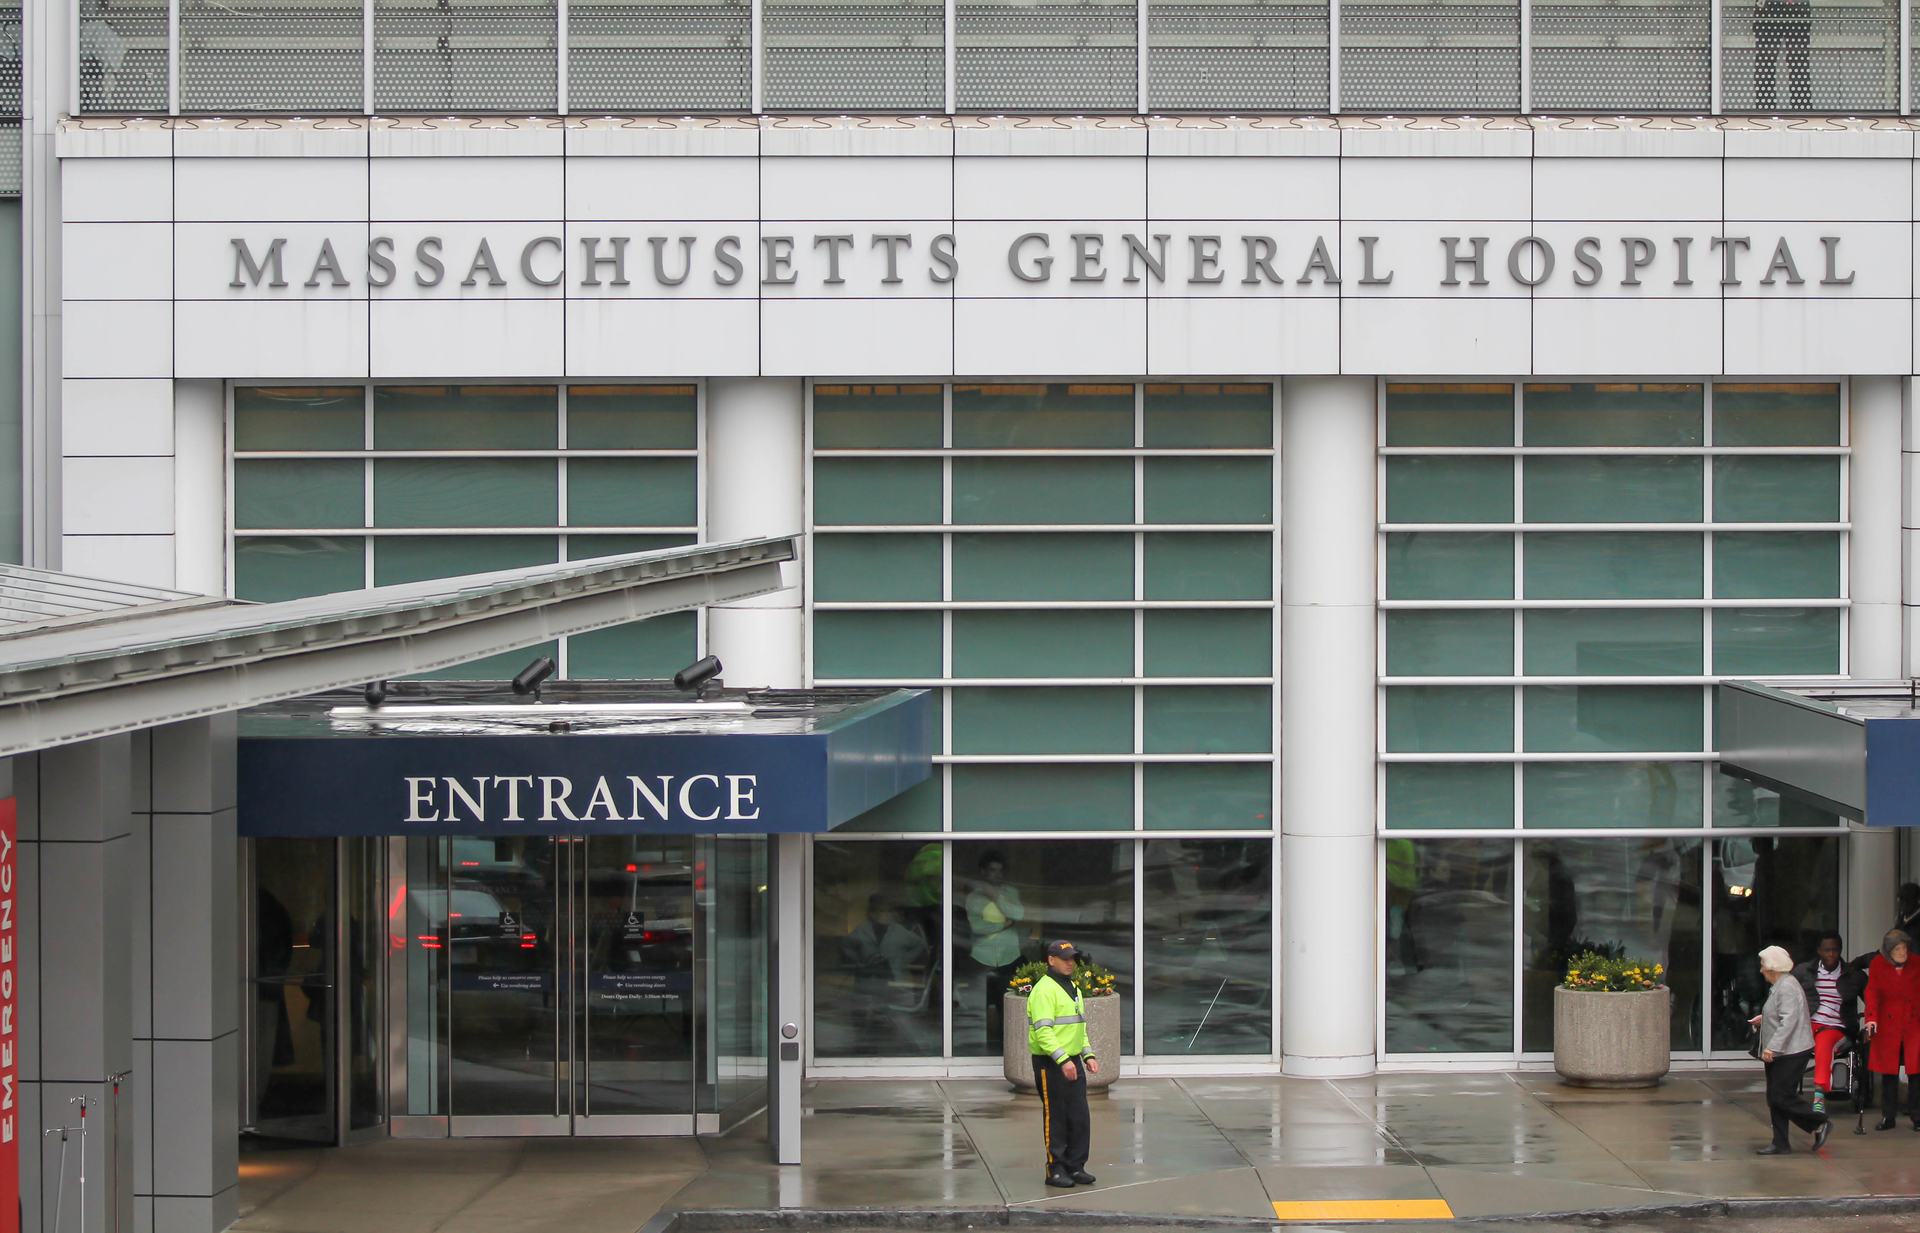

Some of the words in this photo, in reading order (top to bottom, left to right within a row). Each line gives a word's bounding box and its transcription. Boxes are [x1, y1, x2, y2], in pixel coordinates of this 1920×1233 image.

[229, 234, 958, 290] MASSACHUSETTS
[1008, 232, 1394, 284] GENERAL
[1440, 236, 1856, 285] HOSPITAL
[404, 774, 761, 822] ENTRANCE
[1, 830, 13, 1143] EMERGENCY
